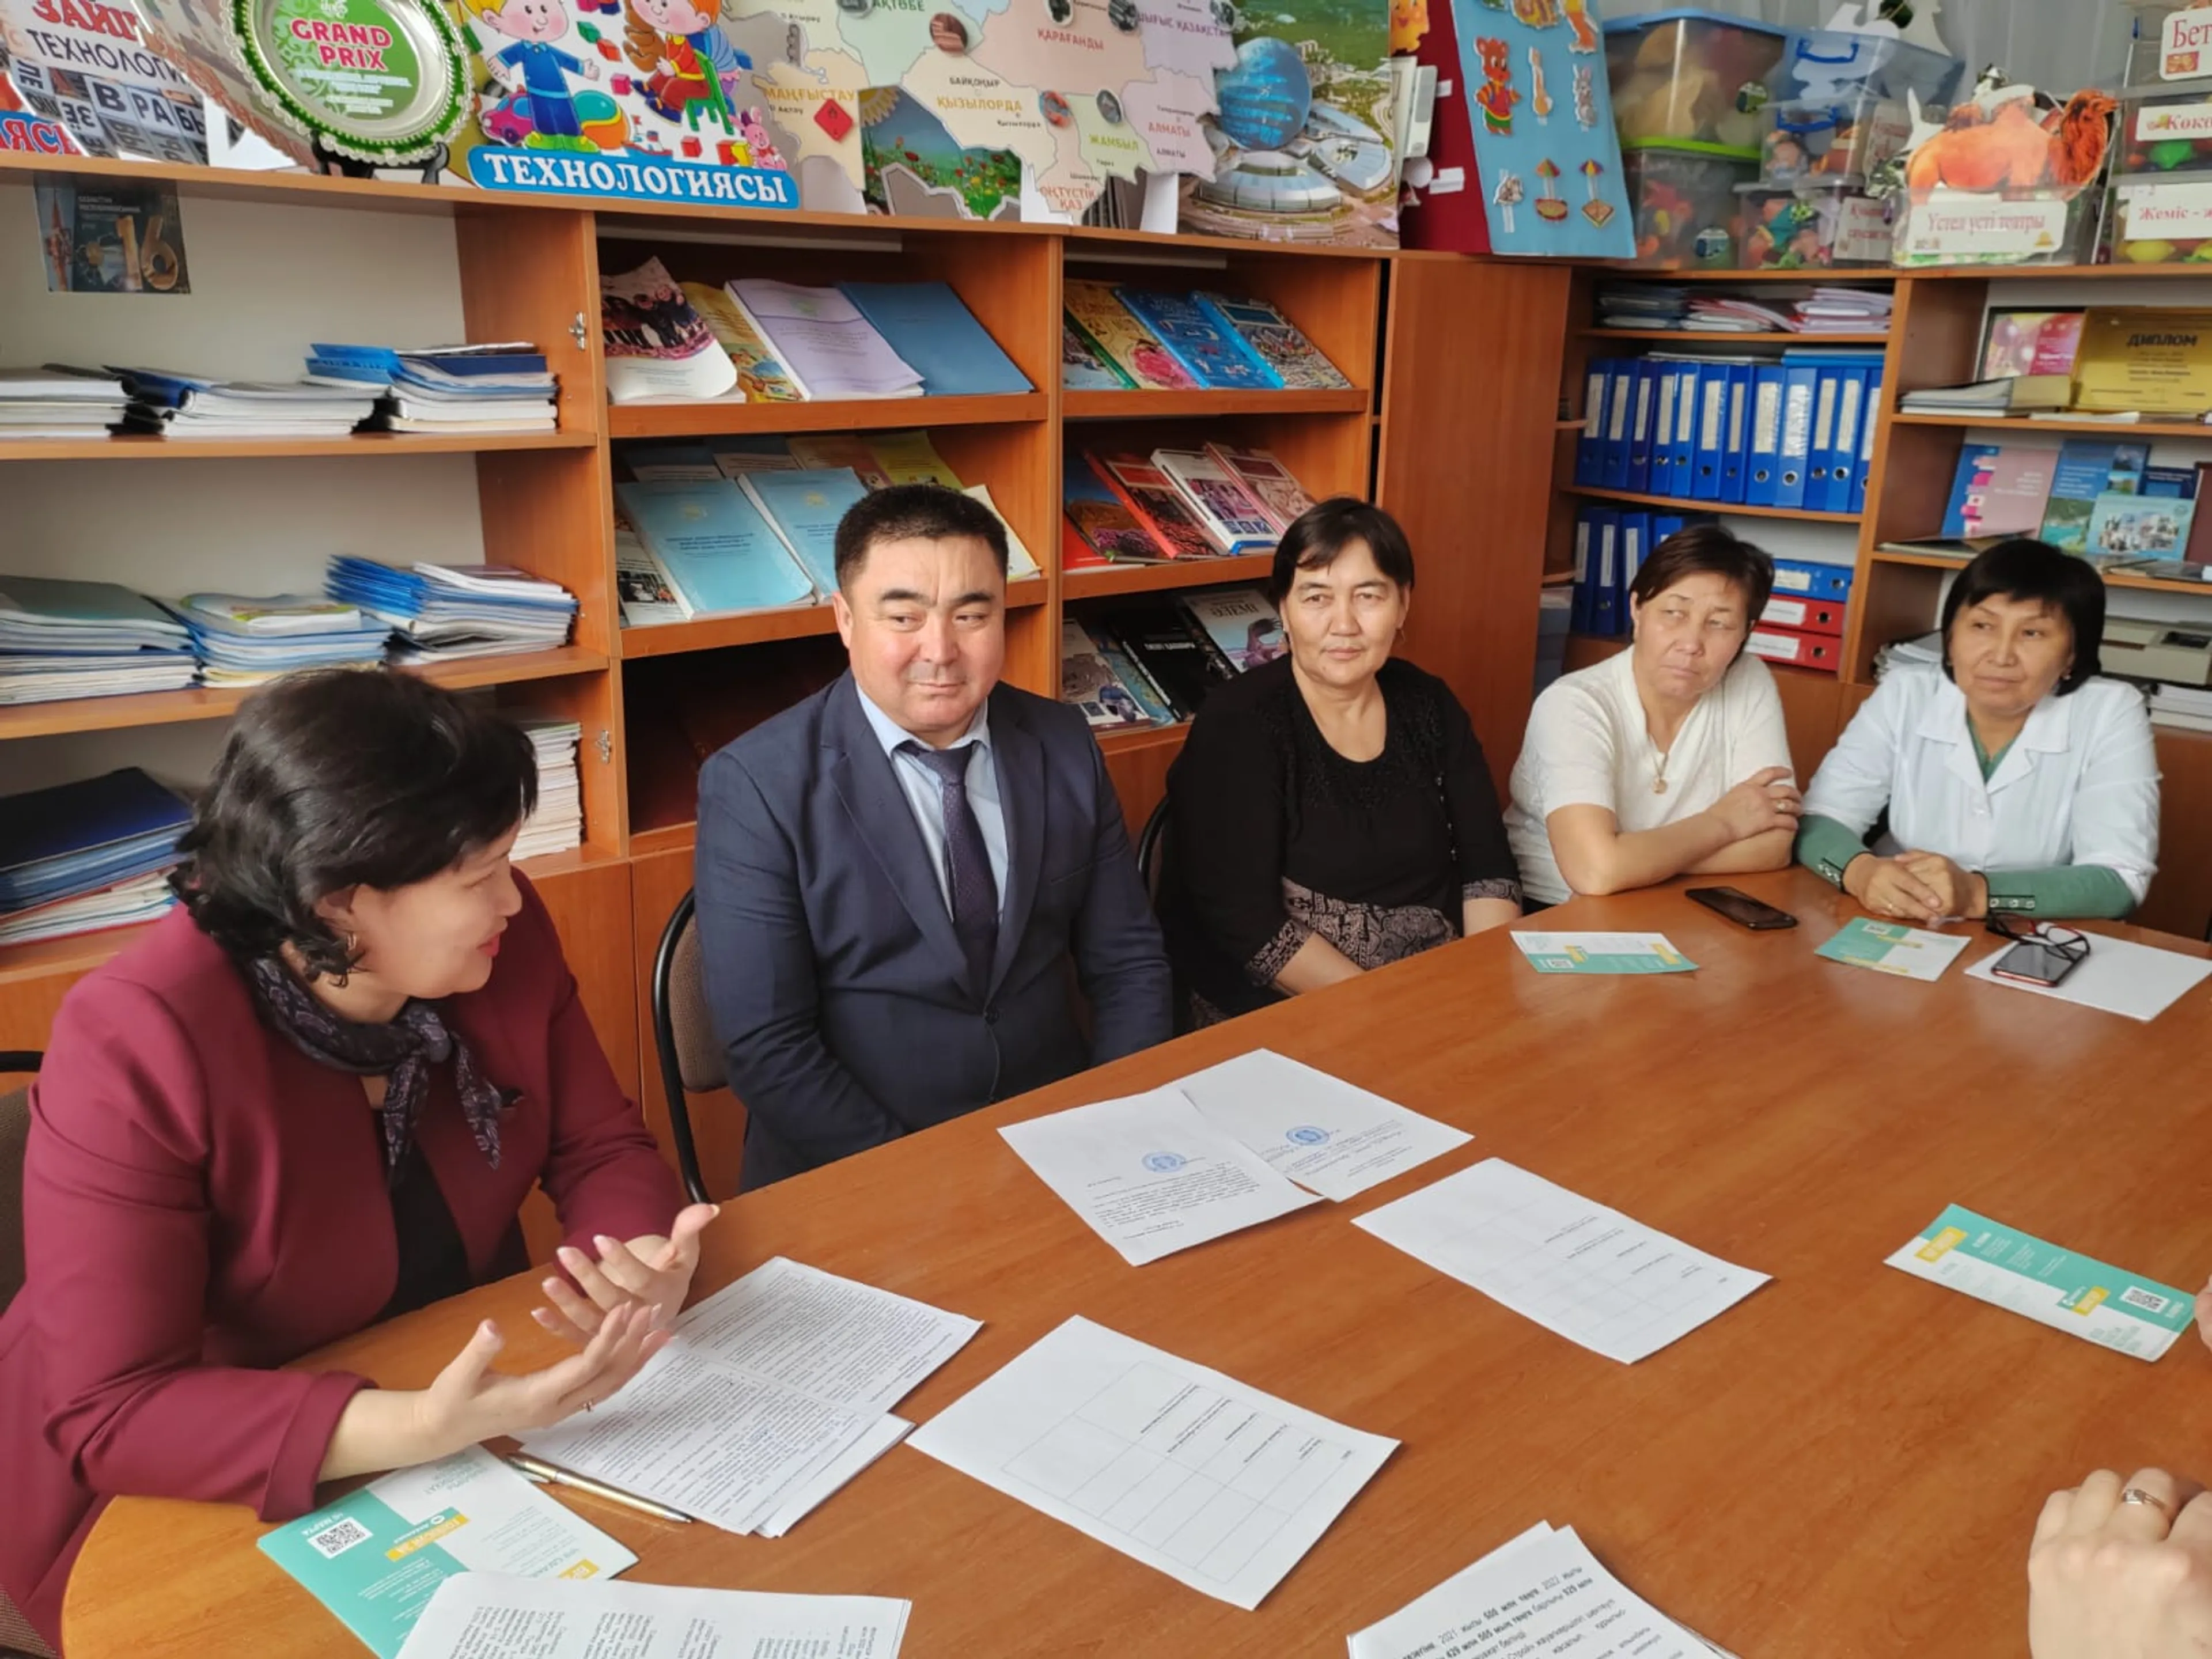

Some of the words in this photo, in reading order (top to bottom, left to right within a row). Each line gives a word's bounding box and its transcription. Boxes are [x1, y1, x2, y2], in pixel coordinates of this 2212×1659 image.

[291, 19, 392, 47] GRAND
[26, 29, 188, 85] ТЕХНОЛОГИ
[319, 45, 387, 70] PRIX
[937, 97, 1022, 112] ҚЫЗЫЛОРДА
[483, 153, 787, 203] ТЕХНОЛОГИЯСЫ
[2126, 334, 2198, 348] ДИПЛОМ
